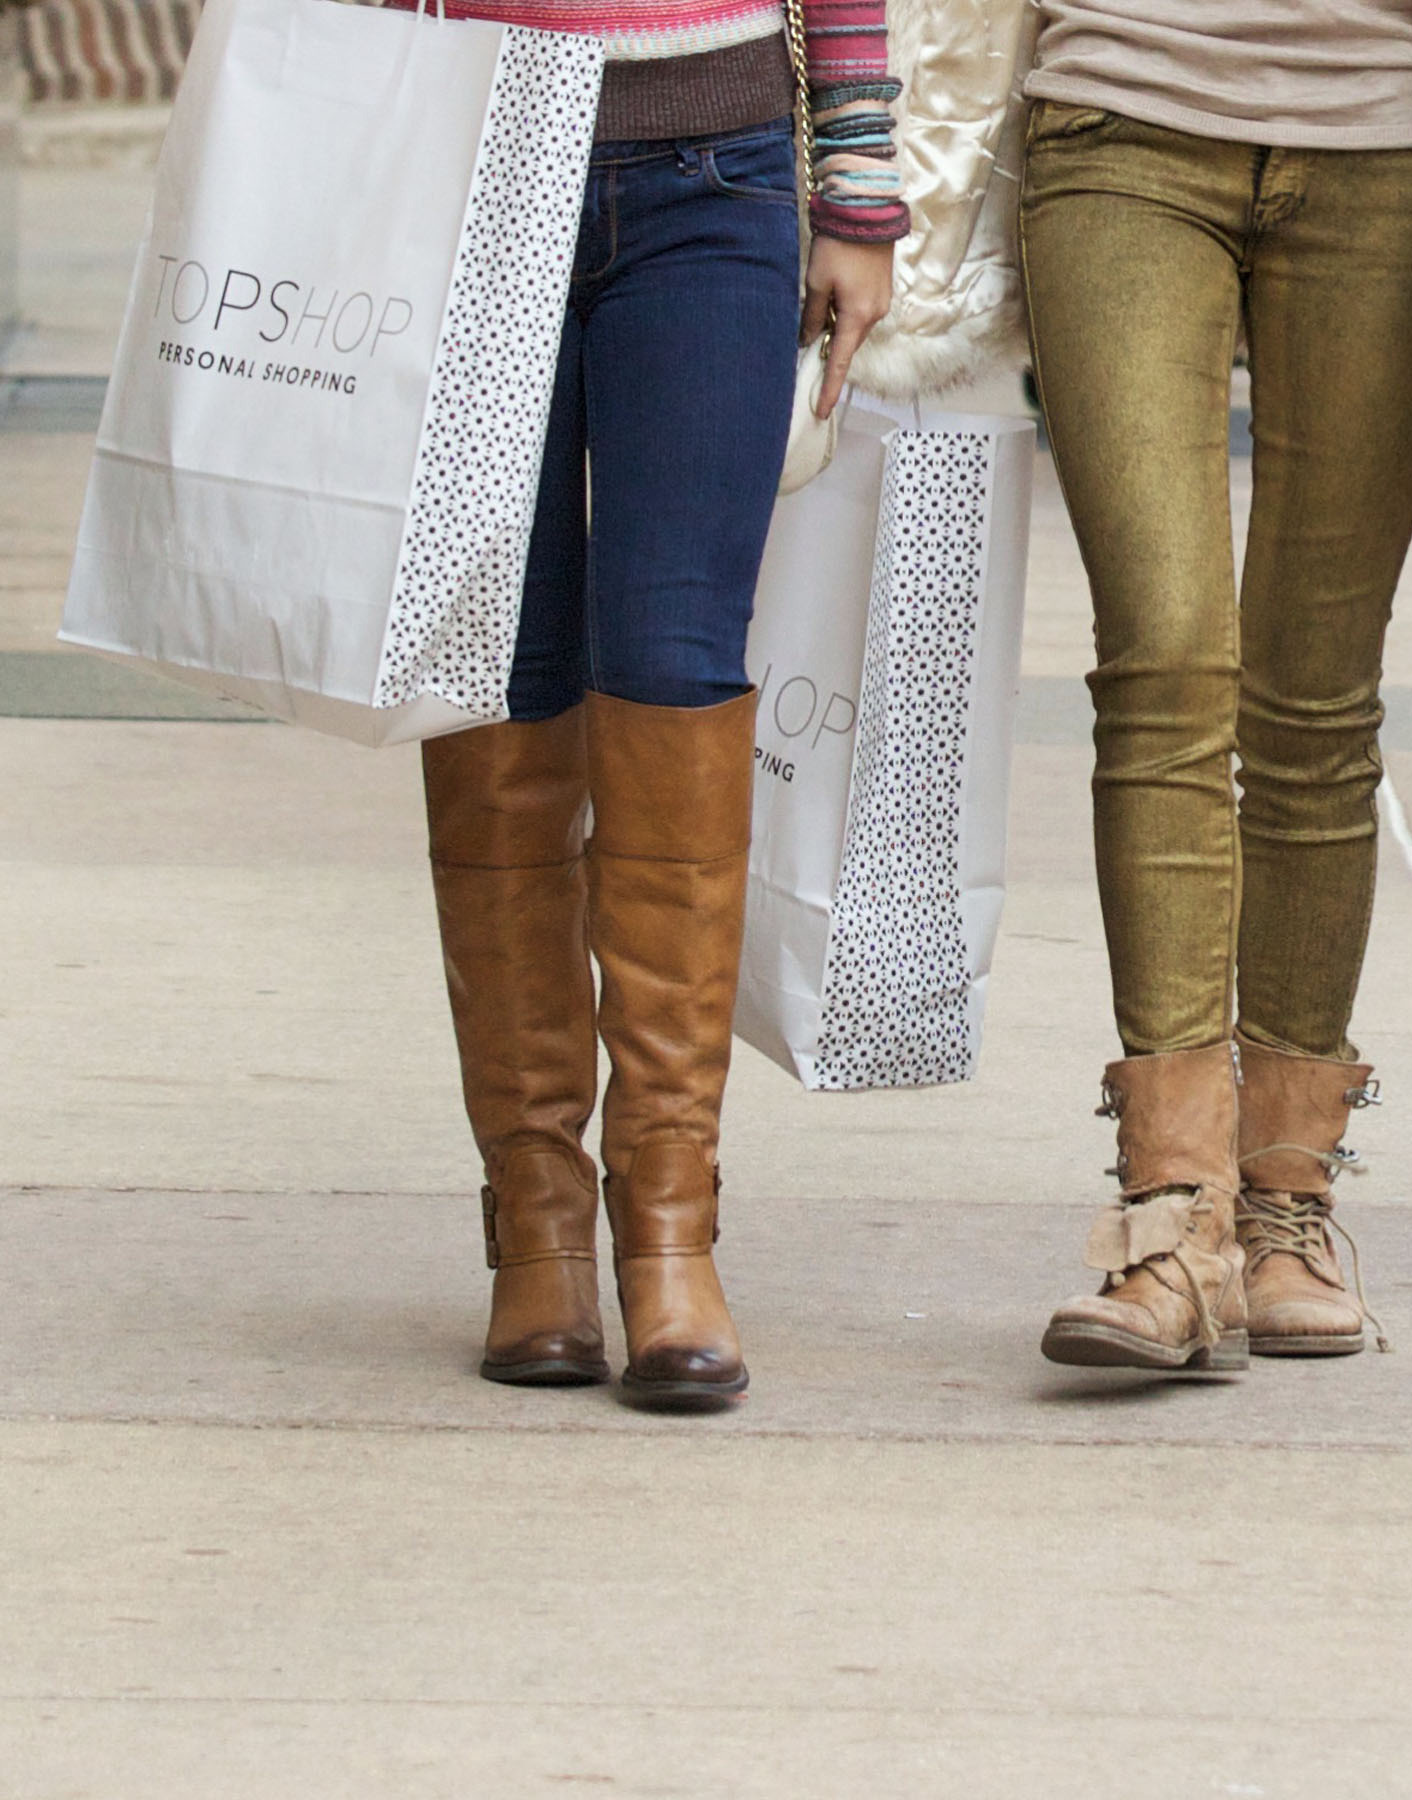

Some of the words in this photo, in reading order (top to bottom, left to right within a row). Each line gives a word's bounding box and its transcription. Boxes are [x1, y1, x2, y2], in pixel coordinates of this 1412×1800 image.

[154, 254, 413, 357] TOPSHOP
[158, 341, 256, 379] PERSONAL
[262, 362, 357, 395] SHOPPING
